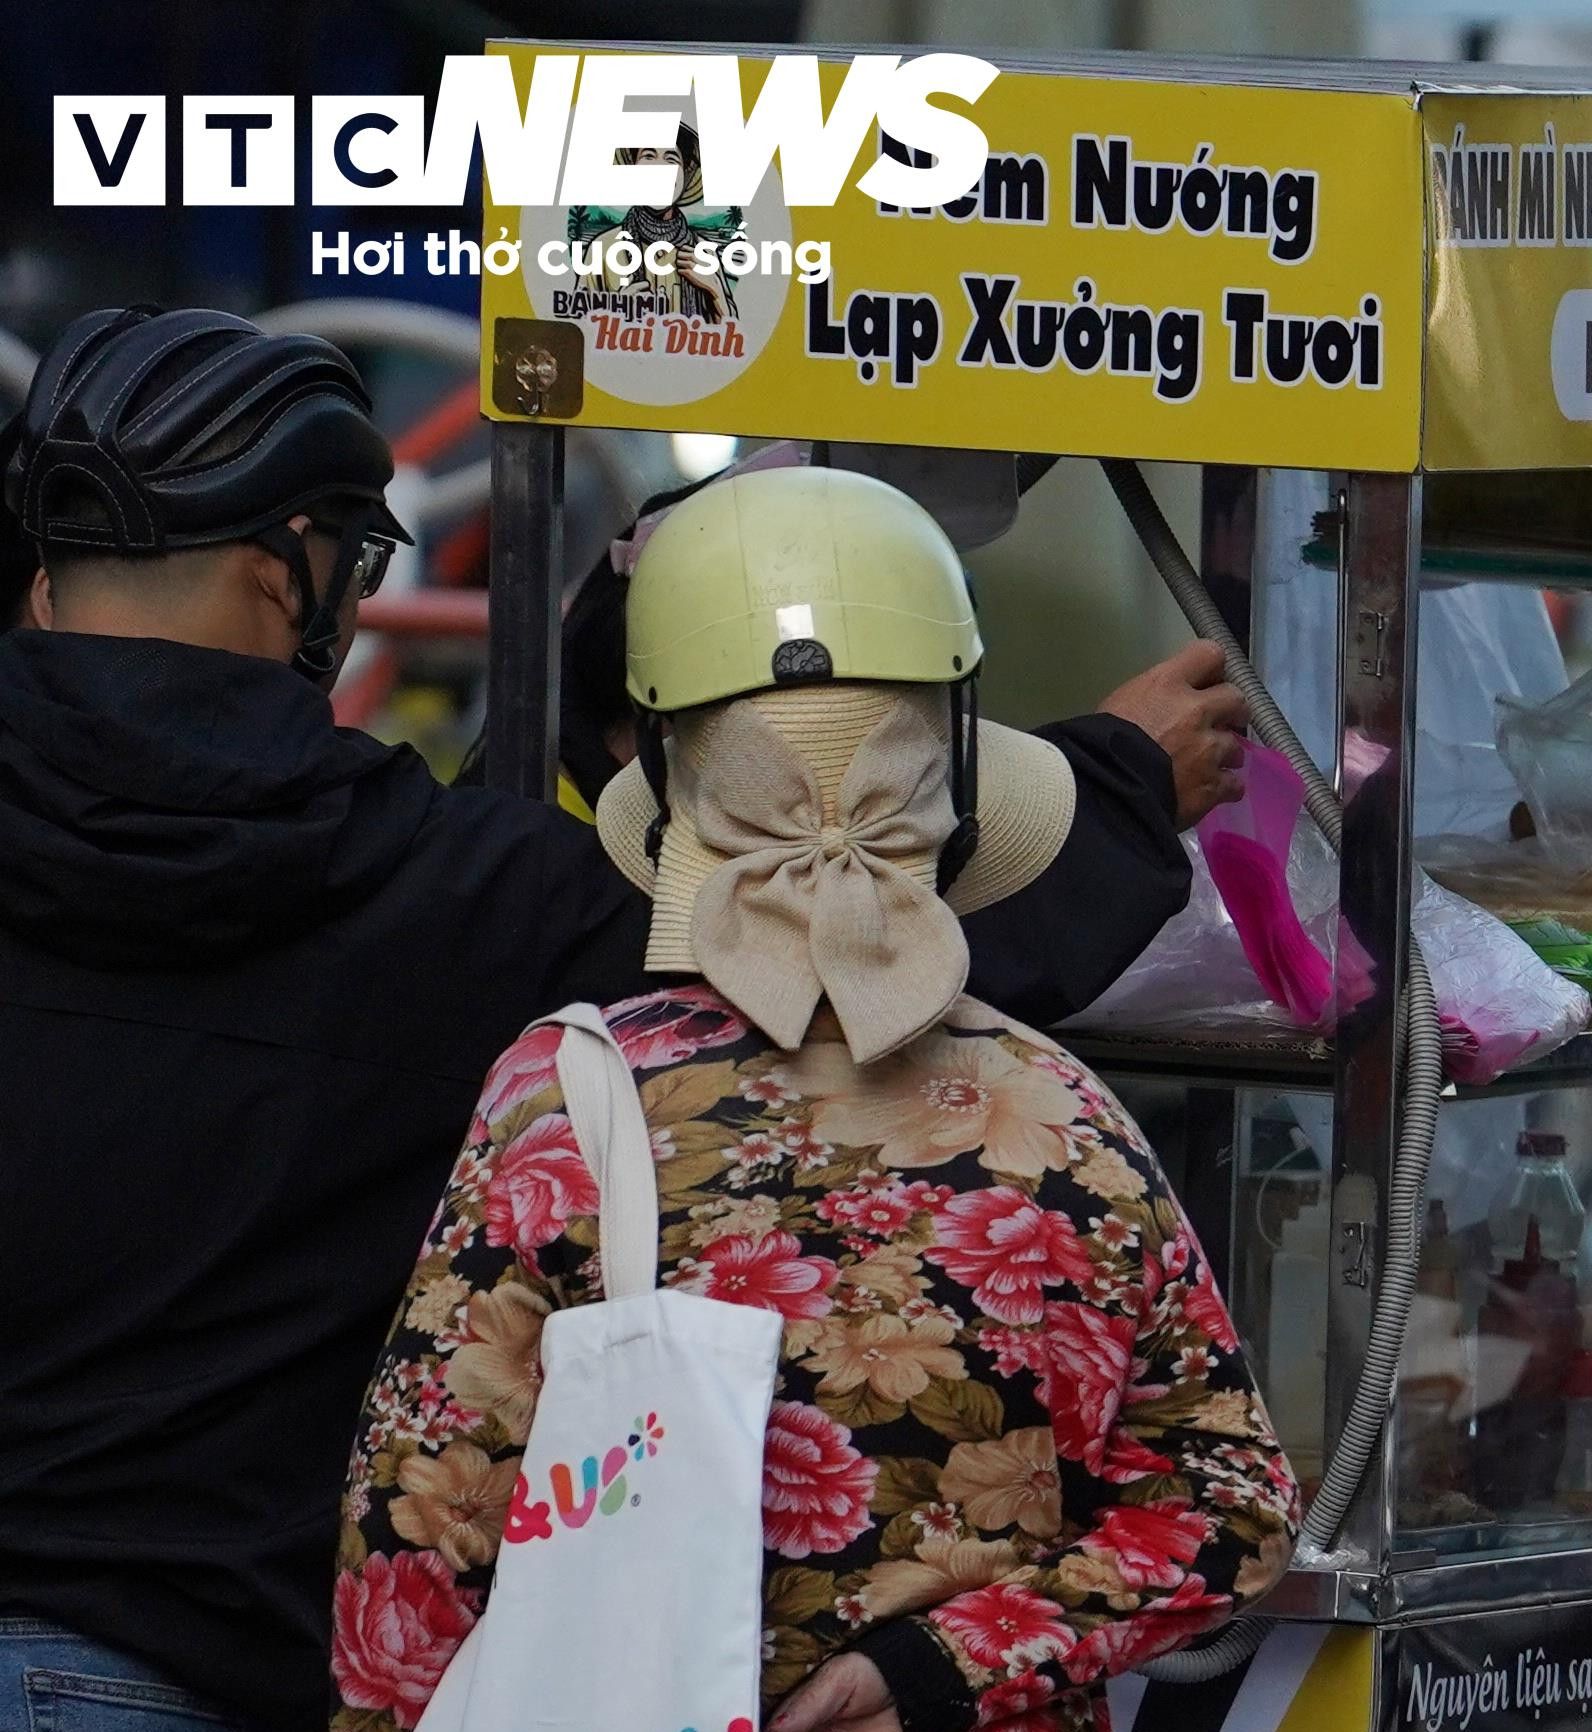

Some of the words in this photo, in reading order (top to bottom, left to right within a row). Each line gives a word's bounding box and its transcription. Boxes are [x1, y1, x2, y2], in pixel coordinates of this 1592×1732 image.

[1075, 142, 1314, 258] Nướng
[1518, 128, 1555, 241] MÌ
[590, 312, 656, 353] Hai
[662, 316, 745, 358] Dinh
[809, 282, 940, 385] Lạp
[964, 278, 1199, 399] Xưởng
[1230, 294, 1382, 387] Tươi
[1406, 1652, 1510, 1732] Nguyên
[1516, 1645, 1562, 1722] liệu
